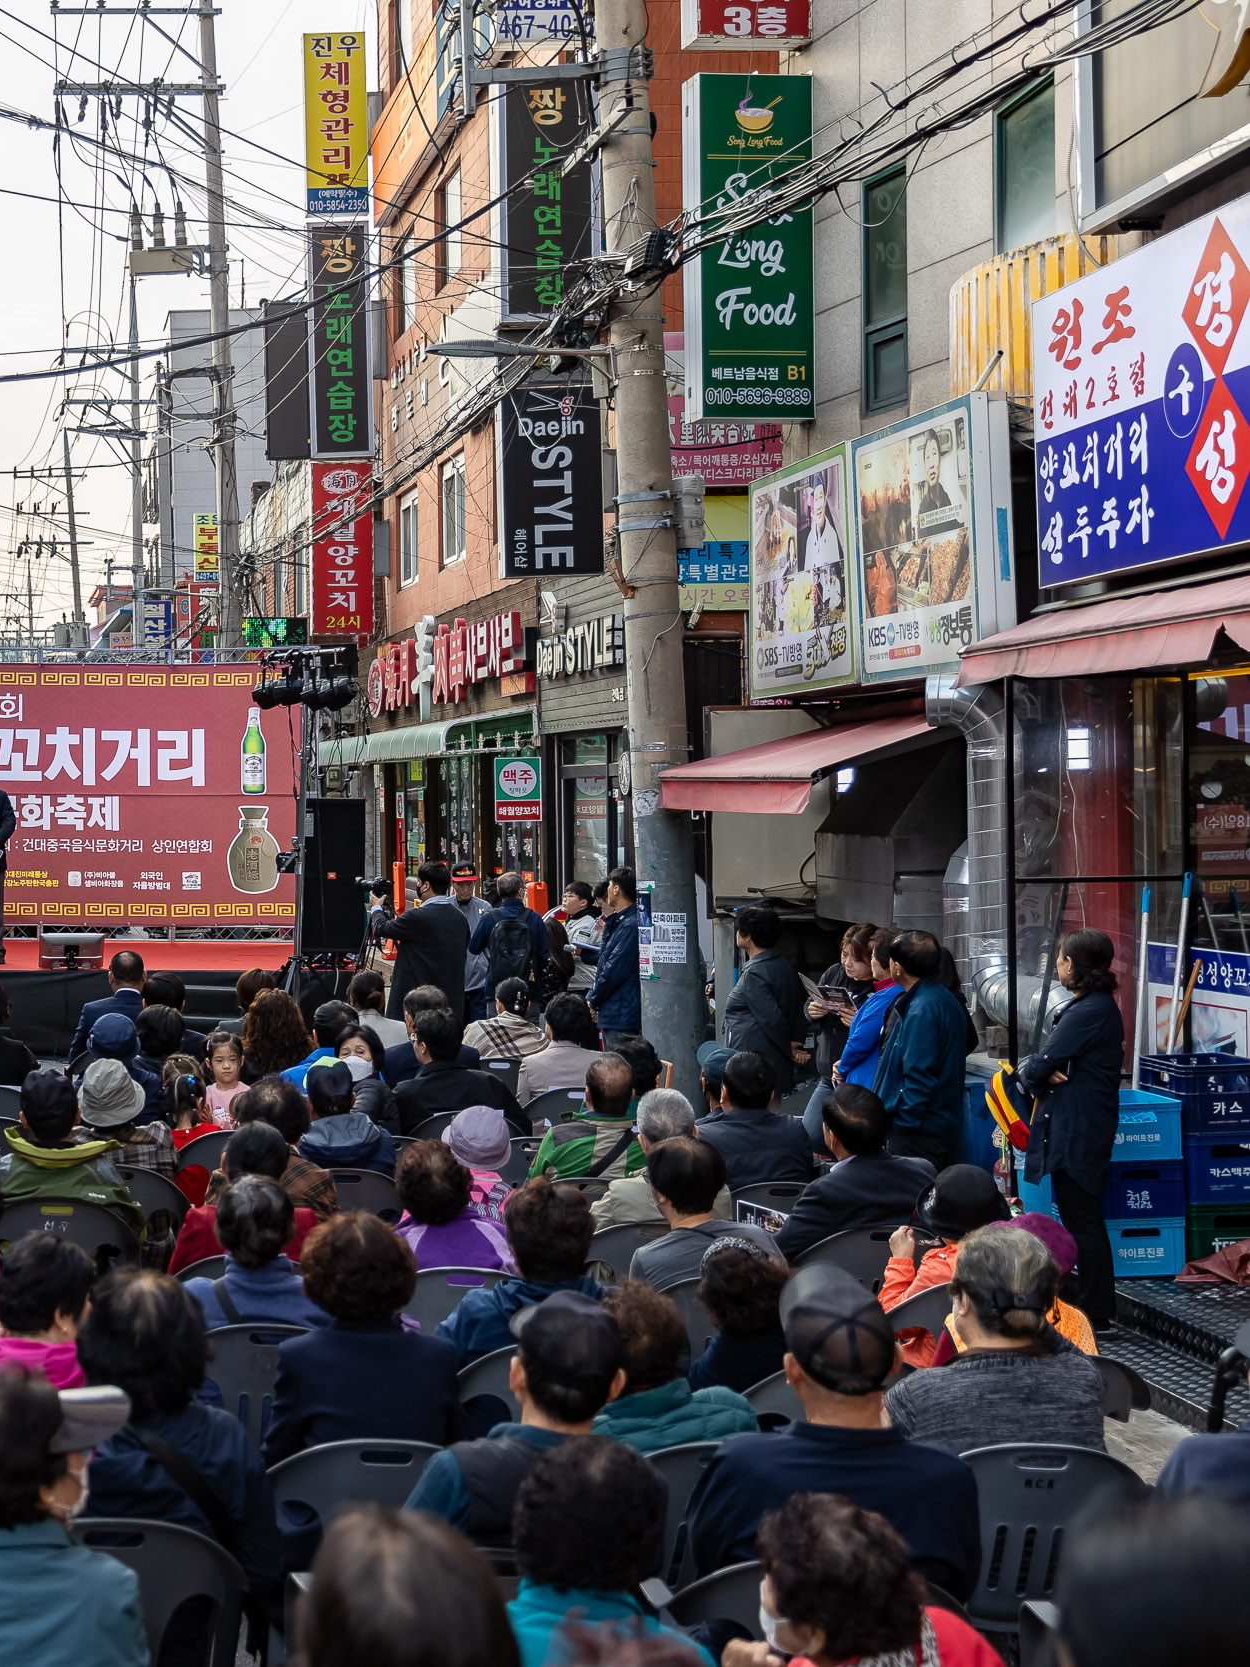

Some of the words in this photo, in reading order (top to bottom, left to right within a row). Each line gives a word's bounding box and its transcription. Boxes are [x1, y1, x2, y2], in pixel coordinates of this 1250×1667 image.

[723, 6, 788, 36] 3층
[311, 35, 361, 58] 진우
[318, 61, 354, 170] 체형관리
[529, 88, 567, 125] 짱
[726, 135, 746, 148] Song
[747, 136, 763, 148] Long
[764, 135, 783, 147] Food
[326, 173, 350, 185] 2F
[533, 136, 562, 305] 노래연습장
[320, 237, 356, 274] 짱
[717, 236, 786, 277] Long
[715, 287, 797, 331] Food
[1048, 286, 1136, 371] 원조
[325, 285, 357, 443] 노래연습장
[711, 367, 778, 381] 베트남음식점
[787, 365, 806, 381] B1
[705, 388, 811, 405] 010-5696-9889
[518, 416, 585, 439] Daejin
[531, 446, 574, 569] STYLE
[514, 529, 527, 568] 헤어샵
[326, 615, 361, 629] 24시
[537, 635, 564, 679] Daejin
[566, 615, 617, 675] STYLE
[868, 626, 886, 648] KBS
[503, 769, 533, 784] 맥주
[498, 806, 539, 816] 해월양꼬치
[22, 838, 143, 853] 건대중국음식문화거리
[152, 839, 213, 854] 상인연합회
[132, 881, 171, 891] 자율방범대
[140, 871, 164, 881] 외국인
[652, 914, 686, 923] 신축아파트
[1125, 1133, 1161, 1143] 하이트진로
[1118, 1246, 1165, 1259] 하이트진로
